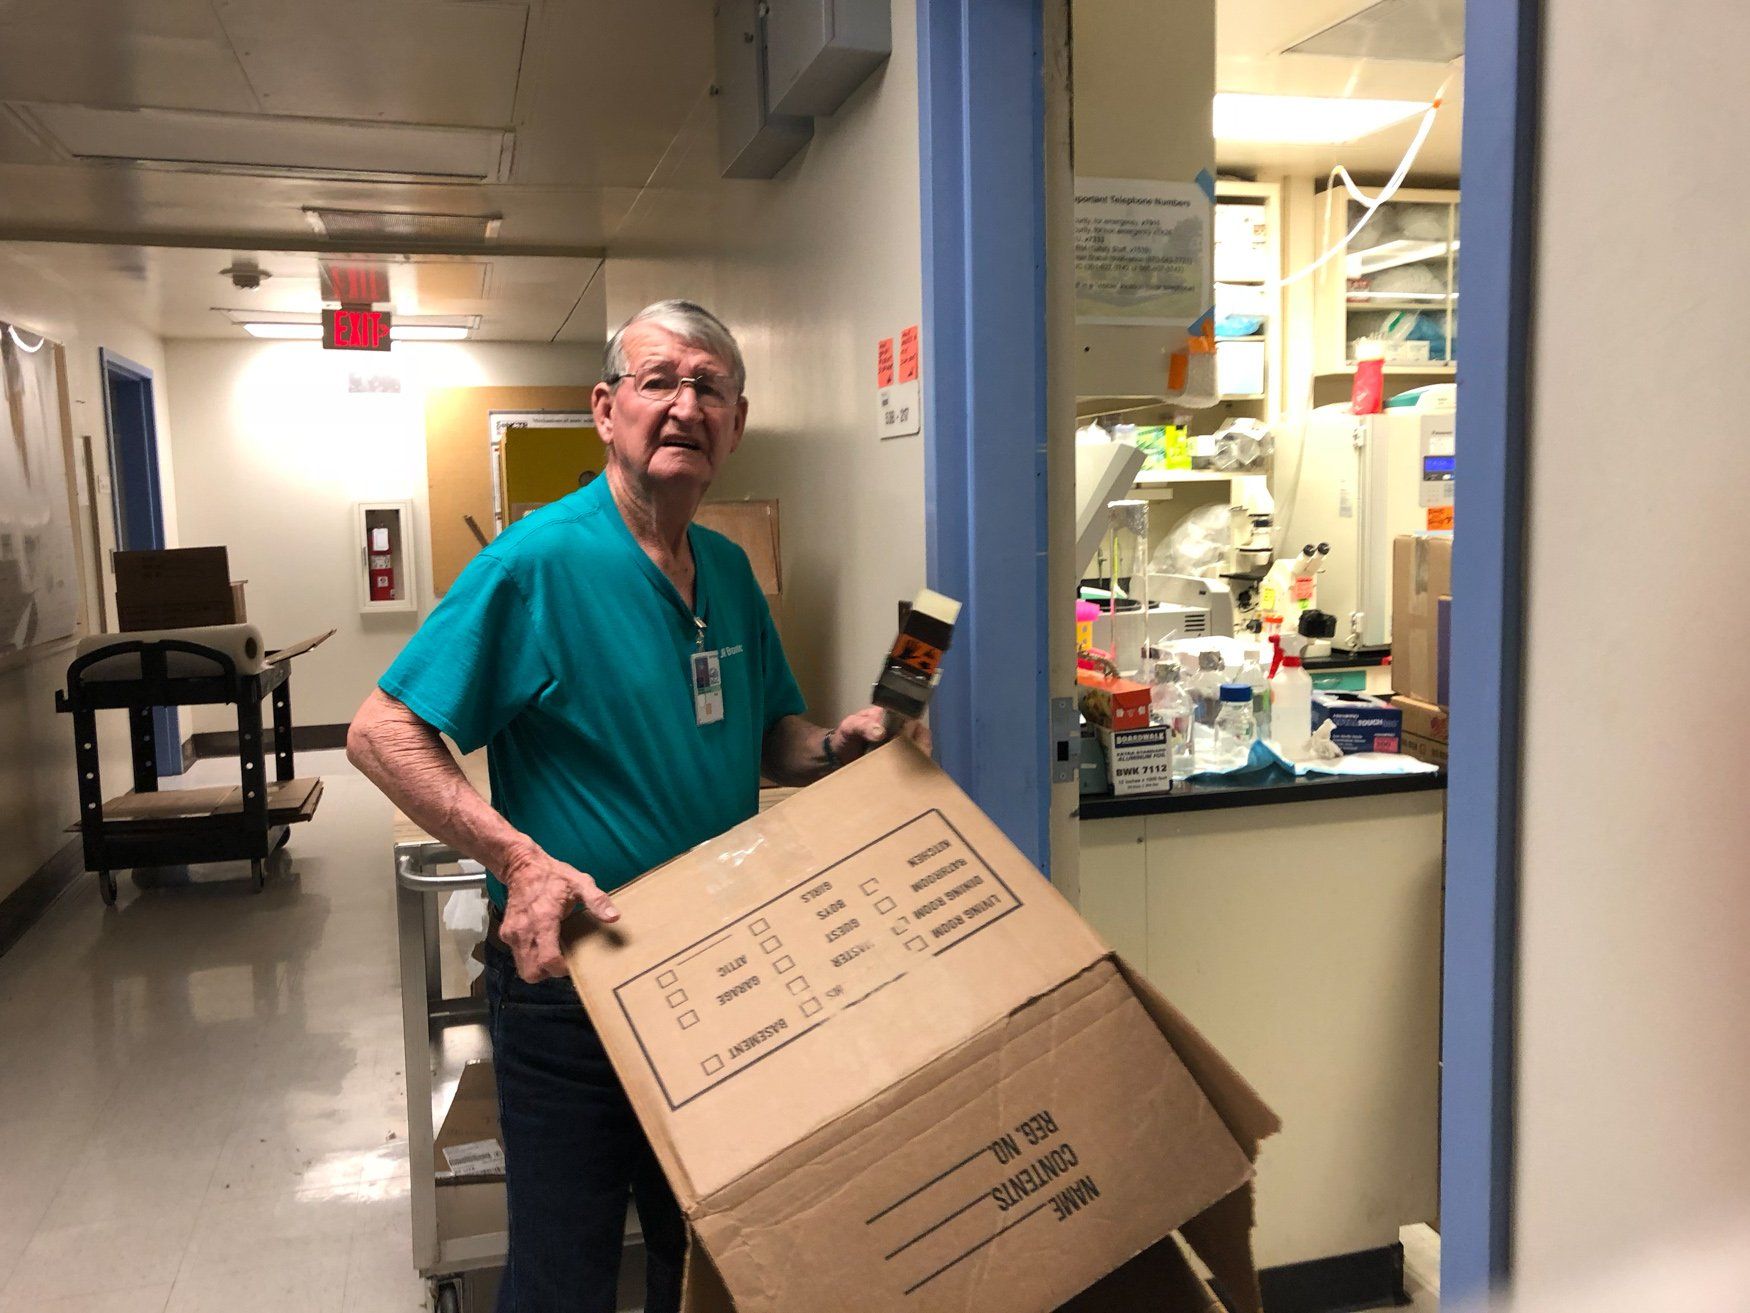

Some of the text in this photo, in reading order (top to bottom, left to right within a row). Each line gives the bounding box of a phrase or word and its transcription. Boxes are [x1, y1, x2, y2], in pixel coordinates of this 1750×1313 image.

[1110, 195, 1152, 207] Telephone
[1154, 198, 1191, 208] Numbers
[333, 310, 382, 348] EXIT
[1116, 731, 1165, 745] BOARDWALK
[1116, 764, 1167, 776] BWK 7112
[907, 839, 951, 868] KITCHEN
[911, 858, 968, 892] BATHROOM
[800, 881, 832, 903] GIRLS
[912, 875, 984, 920] DINING ROOM
[816, 899, 847, 921] BOYS
[931, 894, 1002, 939] LIVING ROOM
[825, 918, 860, 943] GUEST
[716, 954, 748, 977] ATTIC
[716, 975, 761, 1006] GARAGE
[728, 1018, 788, 1060] BASEMENT
[1015, 1110, 1059, 1145] REG.
[992, 1143, 1079, 1211] CONTENTS
[1048, 1175, 1100, 1222] NAME
